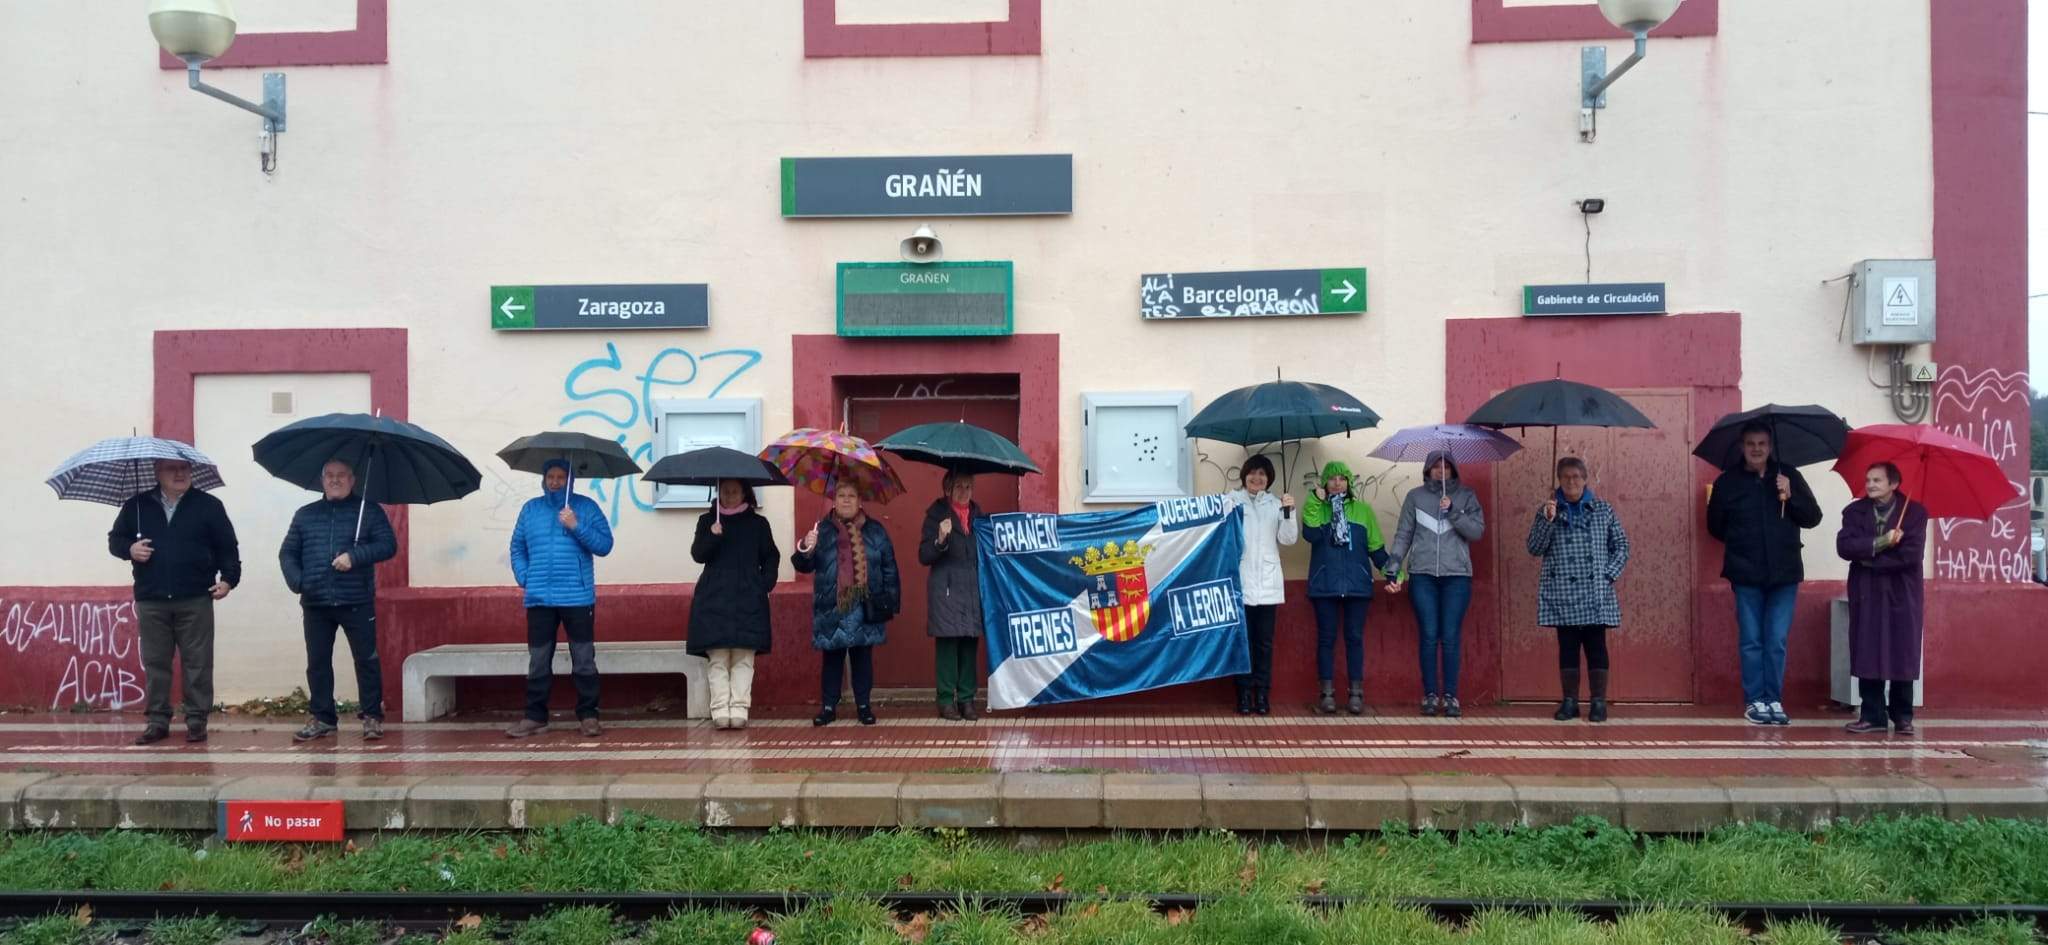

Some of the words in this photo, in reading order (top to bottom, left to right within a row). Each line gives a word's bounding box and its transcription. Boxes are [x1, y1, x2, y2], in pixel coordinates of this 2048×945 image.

[885, 169, 982, 197] GRAÑÉN
[1183, 284, 1279, 304] Barcelona
[1537, 295, 1583, 305] Gabinete
[1587, 293, 1600, 304] de
[1604, 292, 1659, 304] Circulación
[578, 298, 665, 319] Zaragoza
[1142, 304, 1181, 319] TES
[1159, 494, 1223, 526] QUEREMOS
[996, 514, 1058, 551] GRAÑÉN
[1174, 594, 1185, 631] A
[1187, 584, 1237, 626] LERIDA
[1010, 610, 1075, 656] TRENES
[53, 656, 145, 709] ACAB
[265, 815, 281, 827] No
[286, 817, 322, 830] pasar
